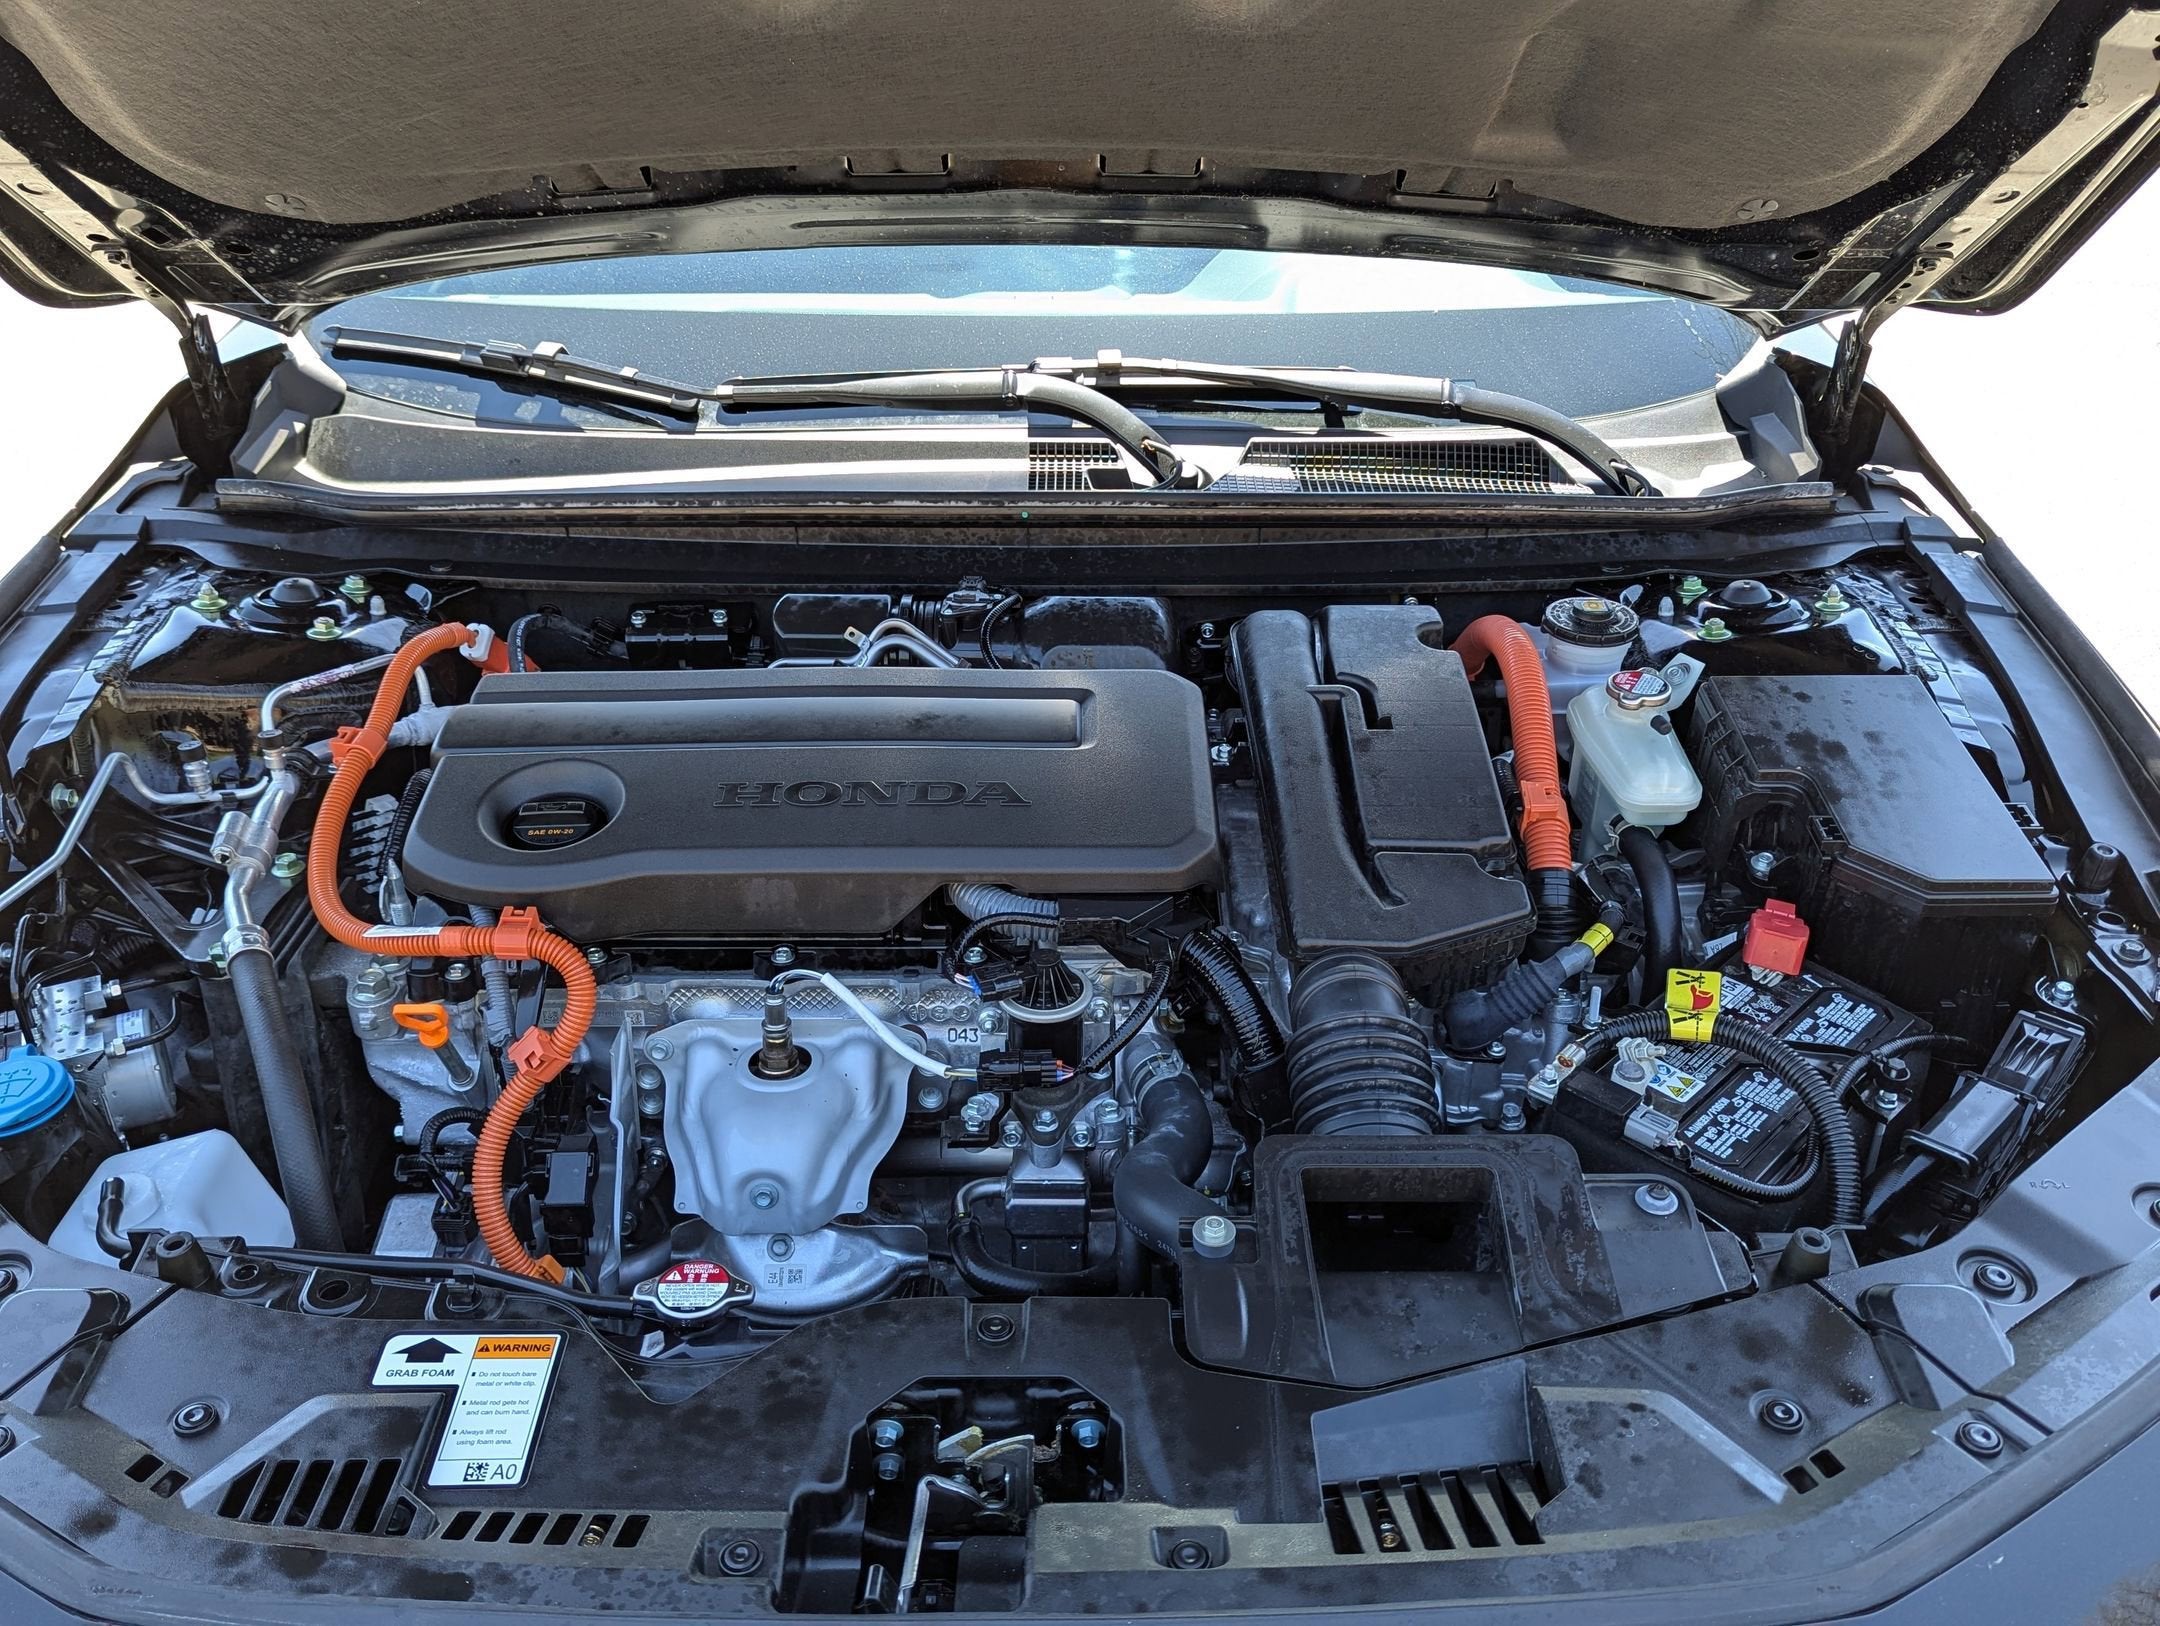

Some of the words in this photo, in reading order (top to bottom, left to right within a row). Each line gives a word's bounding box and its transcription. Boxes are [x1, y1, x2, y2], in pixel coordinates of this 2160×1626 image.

[713, 780, 1032, 807] HONDA
[947, 1027, 979, 1043] 043
[493, 1343, 551, 1353] WARNING
[386, 1369, 419, 1377] GRAB
[421, 1369, 455, 1377] FOAM
[490, 1463, 517, 1480] A0
